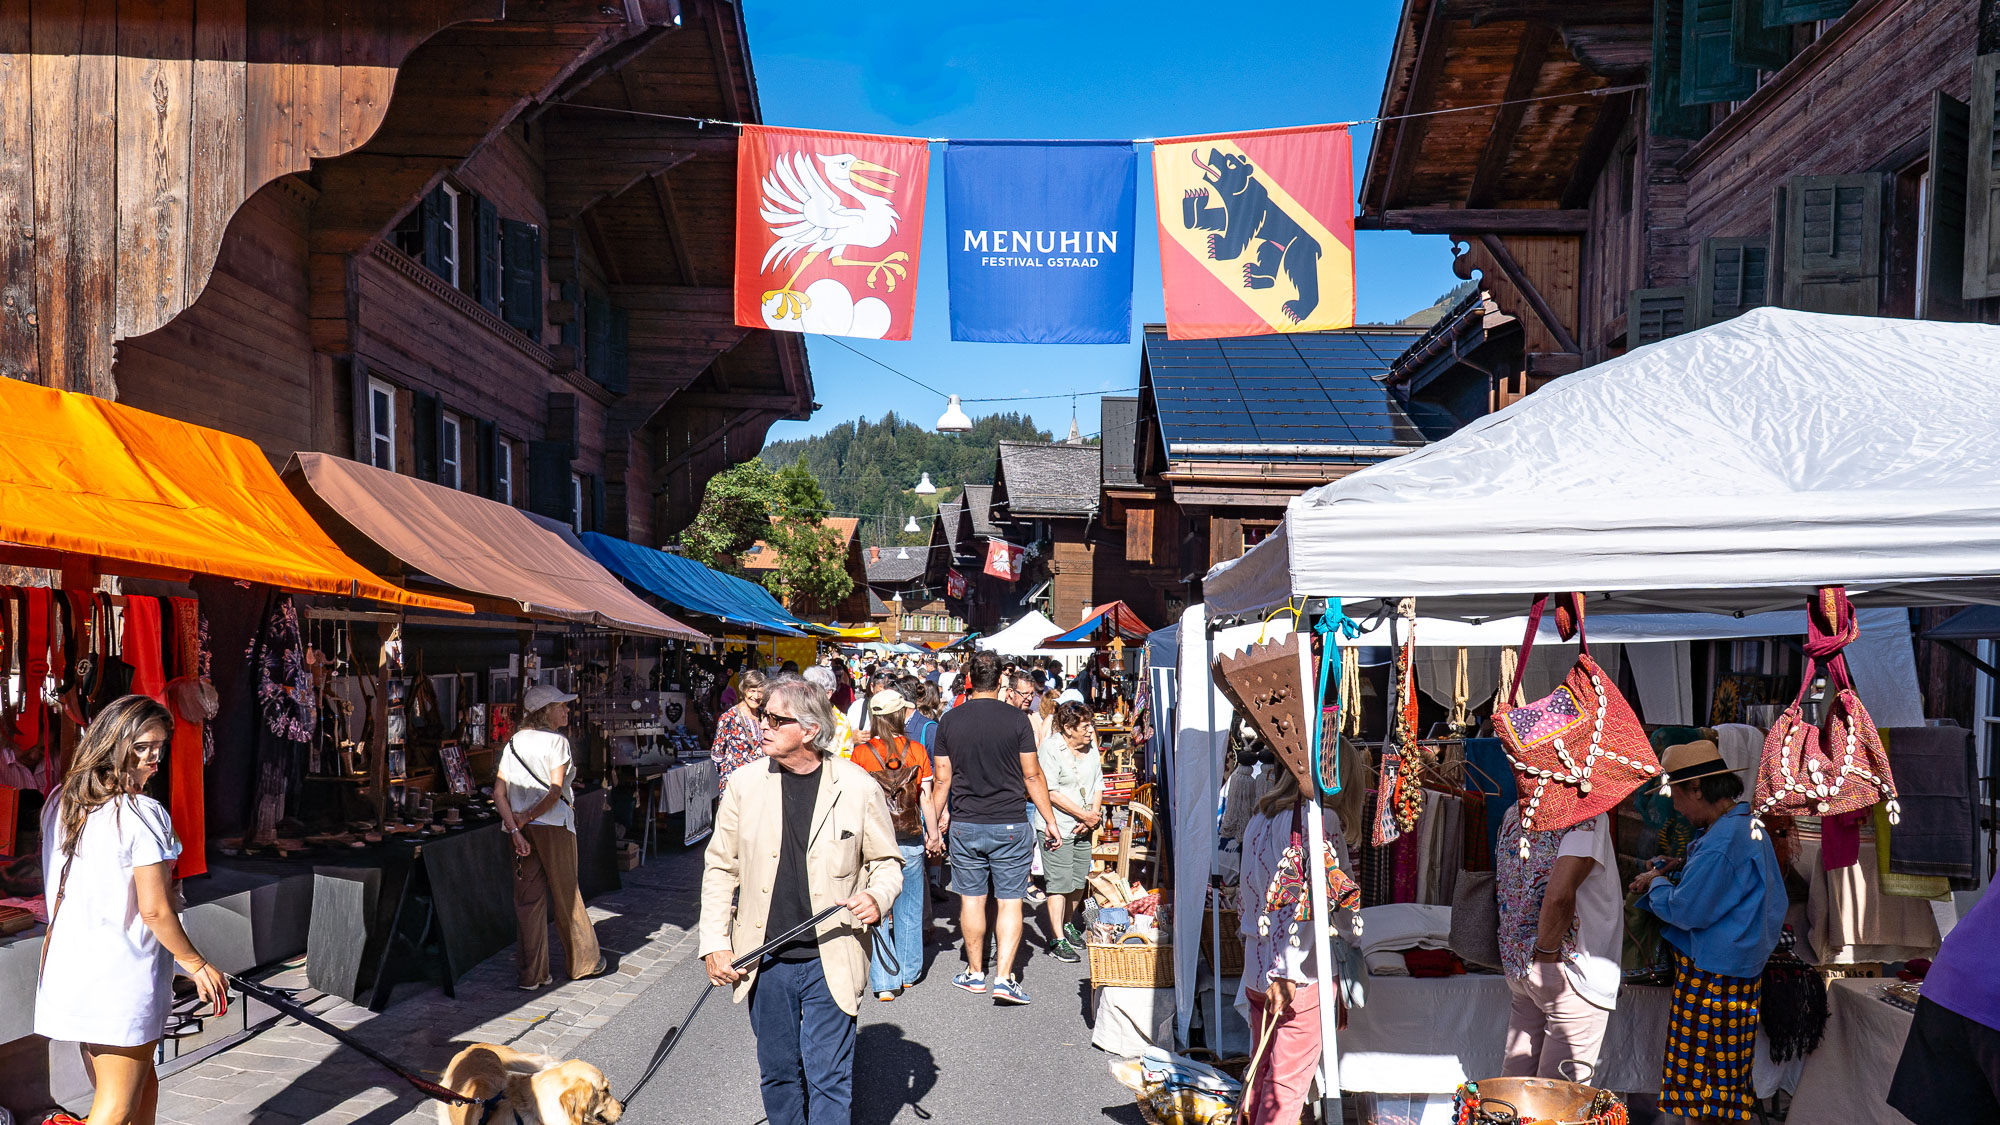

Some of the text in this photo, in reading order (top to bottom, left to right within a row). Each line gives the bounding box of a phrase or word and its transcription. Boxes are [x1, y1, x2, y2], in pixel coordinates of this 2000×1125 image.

[963, 230, 1118, 253] MENUHIN
[981, 257, 1099, 267] FESTIVAL GSTAAD
